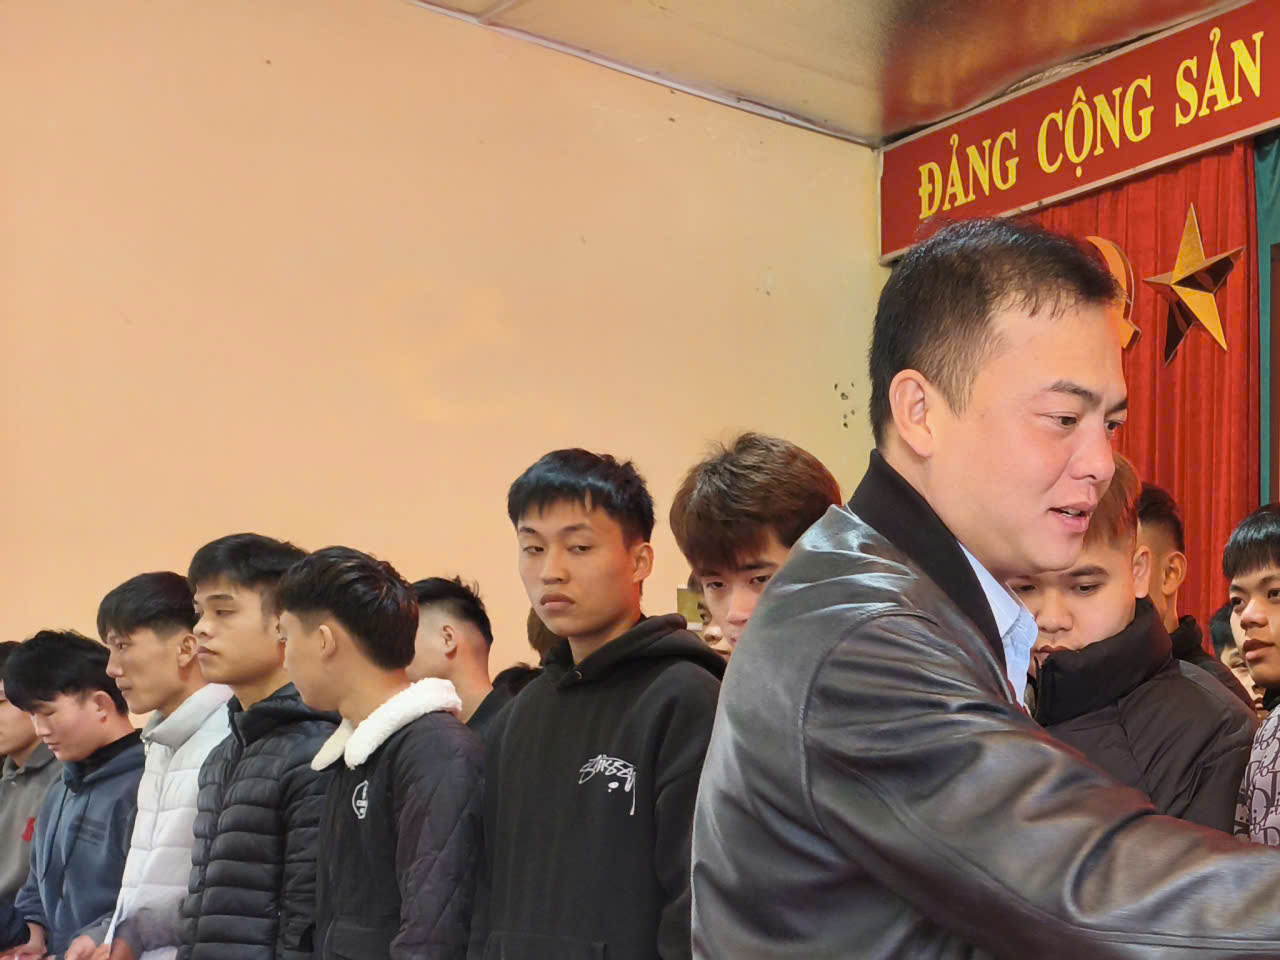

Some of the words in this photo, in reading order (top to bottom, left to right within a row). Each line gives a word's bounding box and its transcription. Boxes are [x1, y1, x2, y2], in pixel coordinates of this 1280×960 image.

[918, 135, 1018, 219] ĐẢNG
[1037, 85, 1154, 177] CỘNG
[1175, 28, 1264, 127] SẢN
